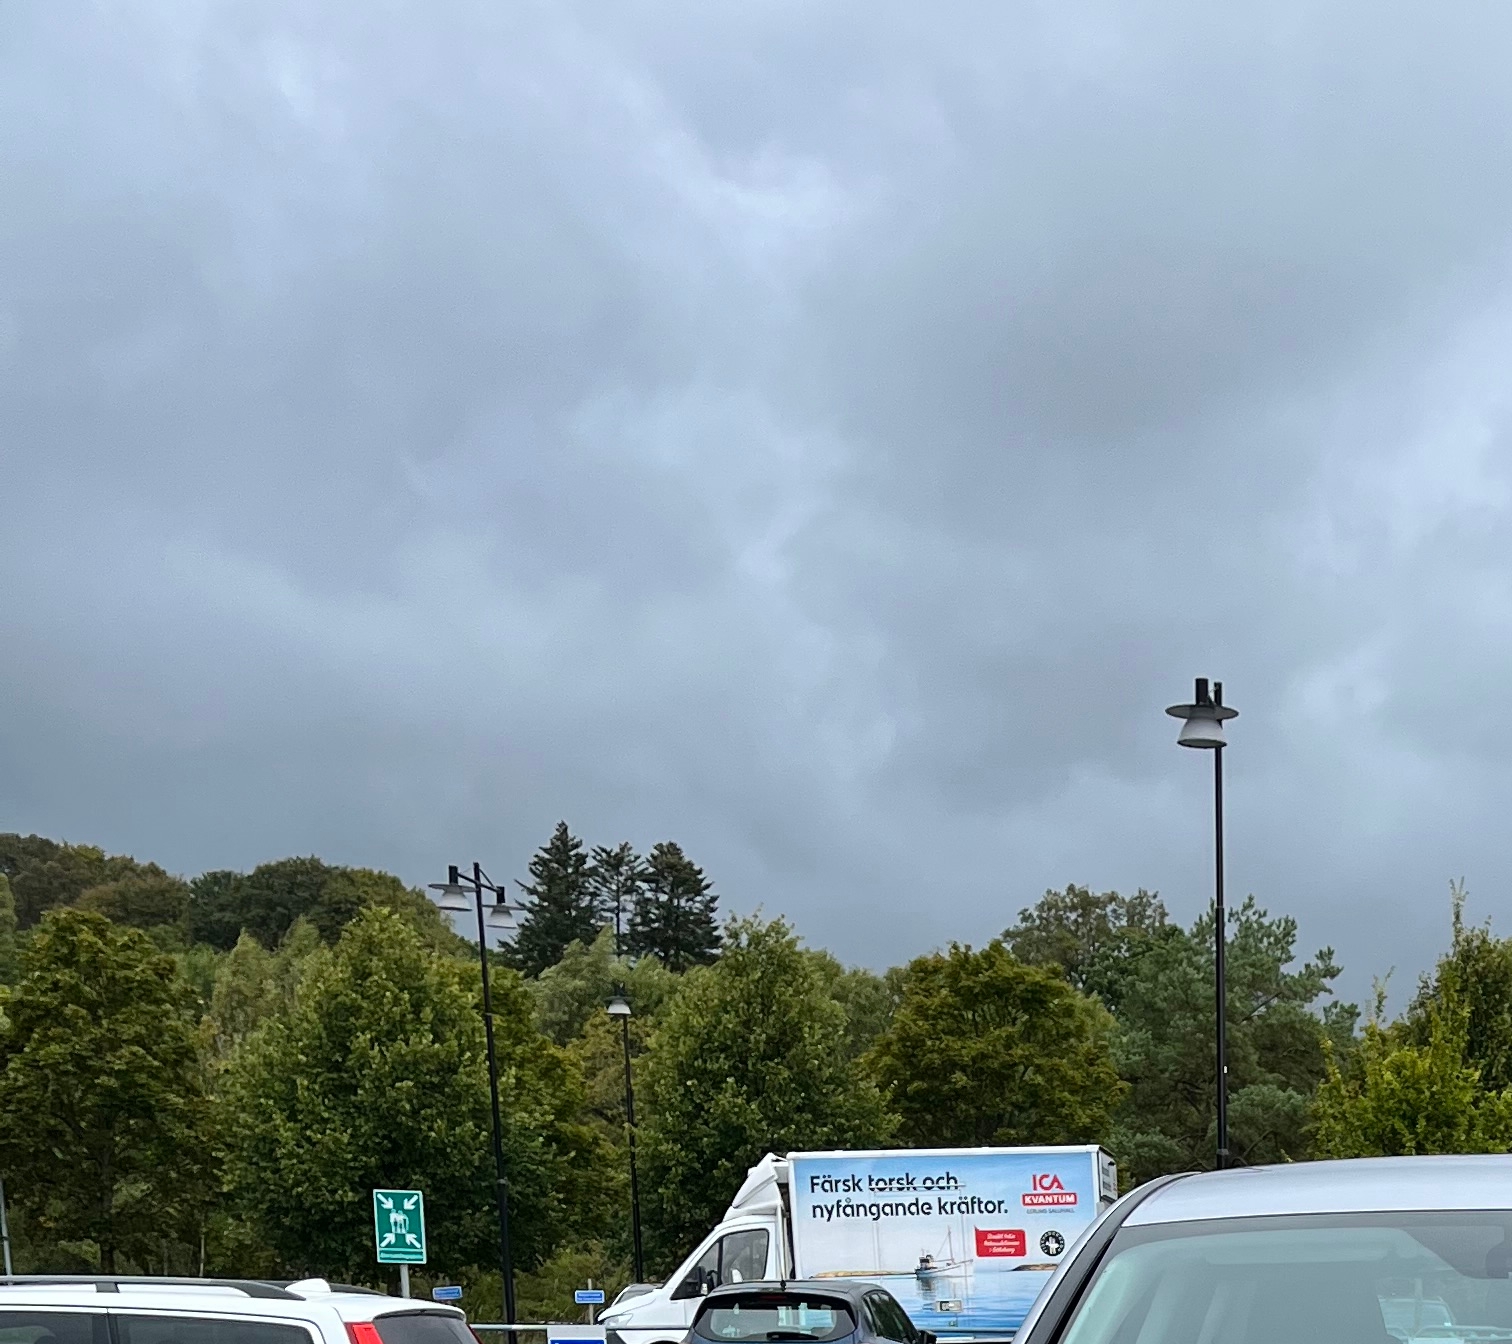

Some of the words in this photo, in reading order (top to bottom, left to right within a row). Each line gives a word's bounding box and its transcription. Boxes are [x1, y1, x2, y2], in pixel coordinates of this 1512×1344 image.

[810, 1174, 863, 1193] Färsk
[868, 1172, 918, 1192] torsk
[922, 1171, 958, 1191] och
[1032, 1173, 1065, 1191] ICA
[1024, 1193, 1075, 1204] KVANTUM
[812, 1198, 933, 1222] nyfångande
[938, 1196, 1008, 1216] kräftor.
